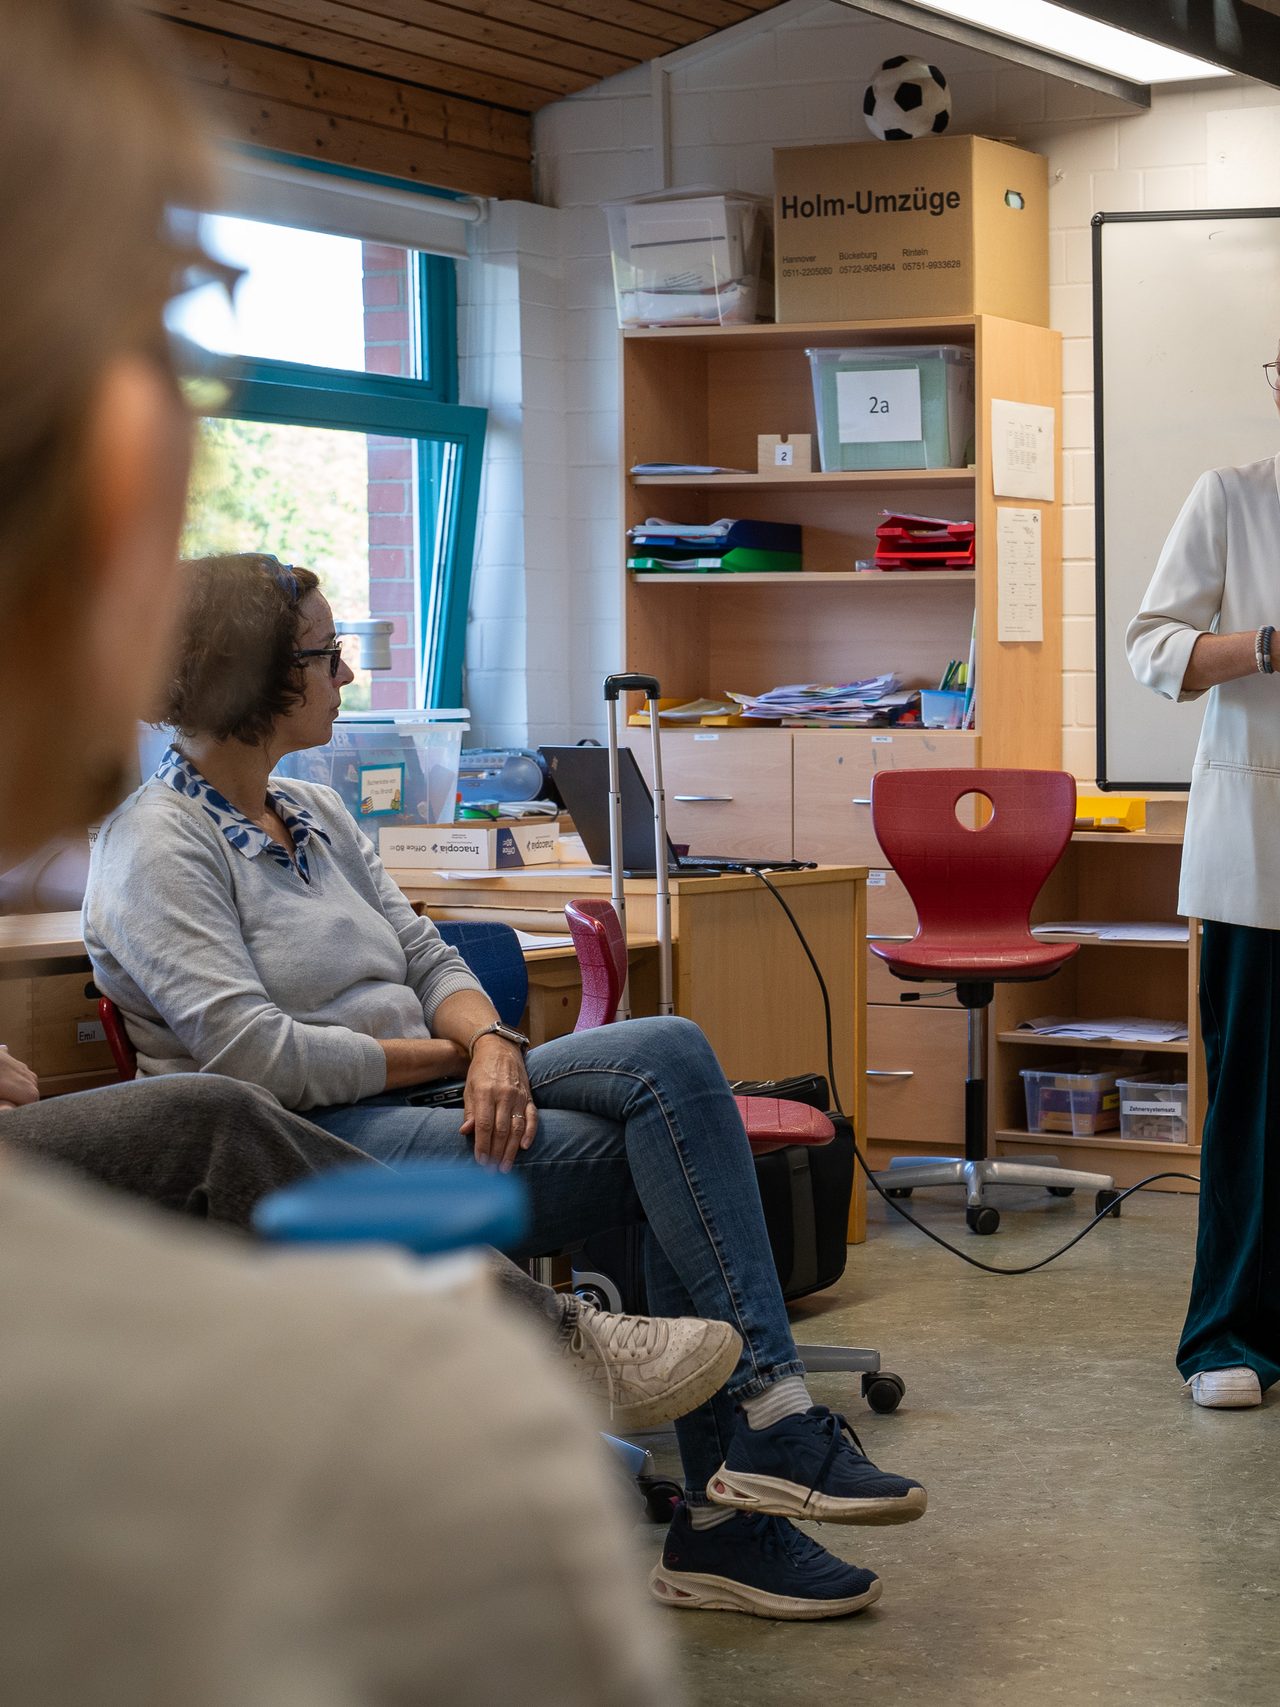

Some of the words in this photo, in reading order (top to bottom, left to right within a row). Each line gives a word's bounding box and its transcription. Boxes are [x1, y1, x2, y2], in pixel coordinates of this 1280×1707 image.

[782, 187, 961, 219] Holm-Umzüge
[869, 396, 889, 414] 2a
[781, 451, 787, 461] 2
[406, 844, 427, 853] Office
[440, 843, 480, 855] Inacopia
[531, 839, 555, 852] Inacopia
[79, 1031, 96, 1041] Emil
